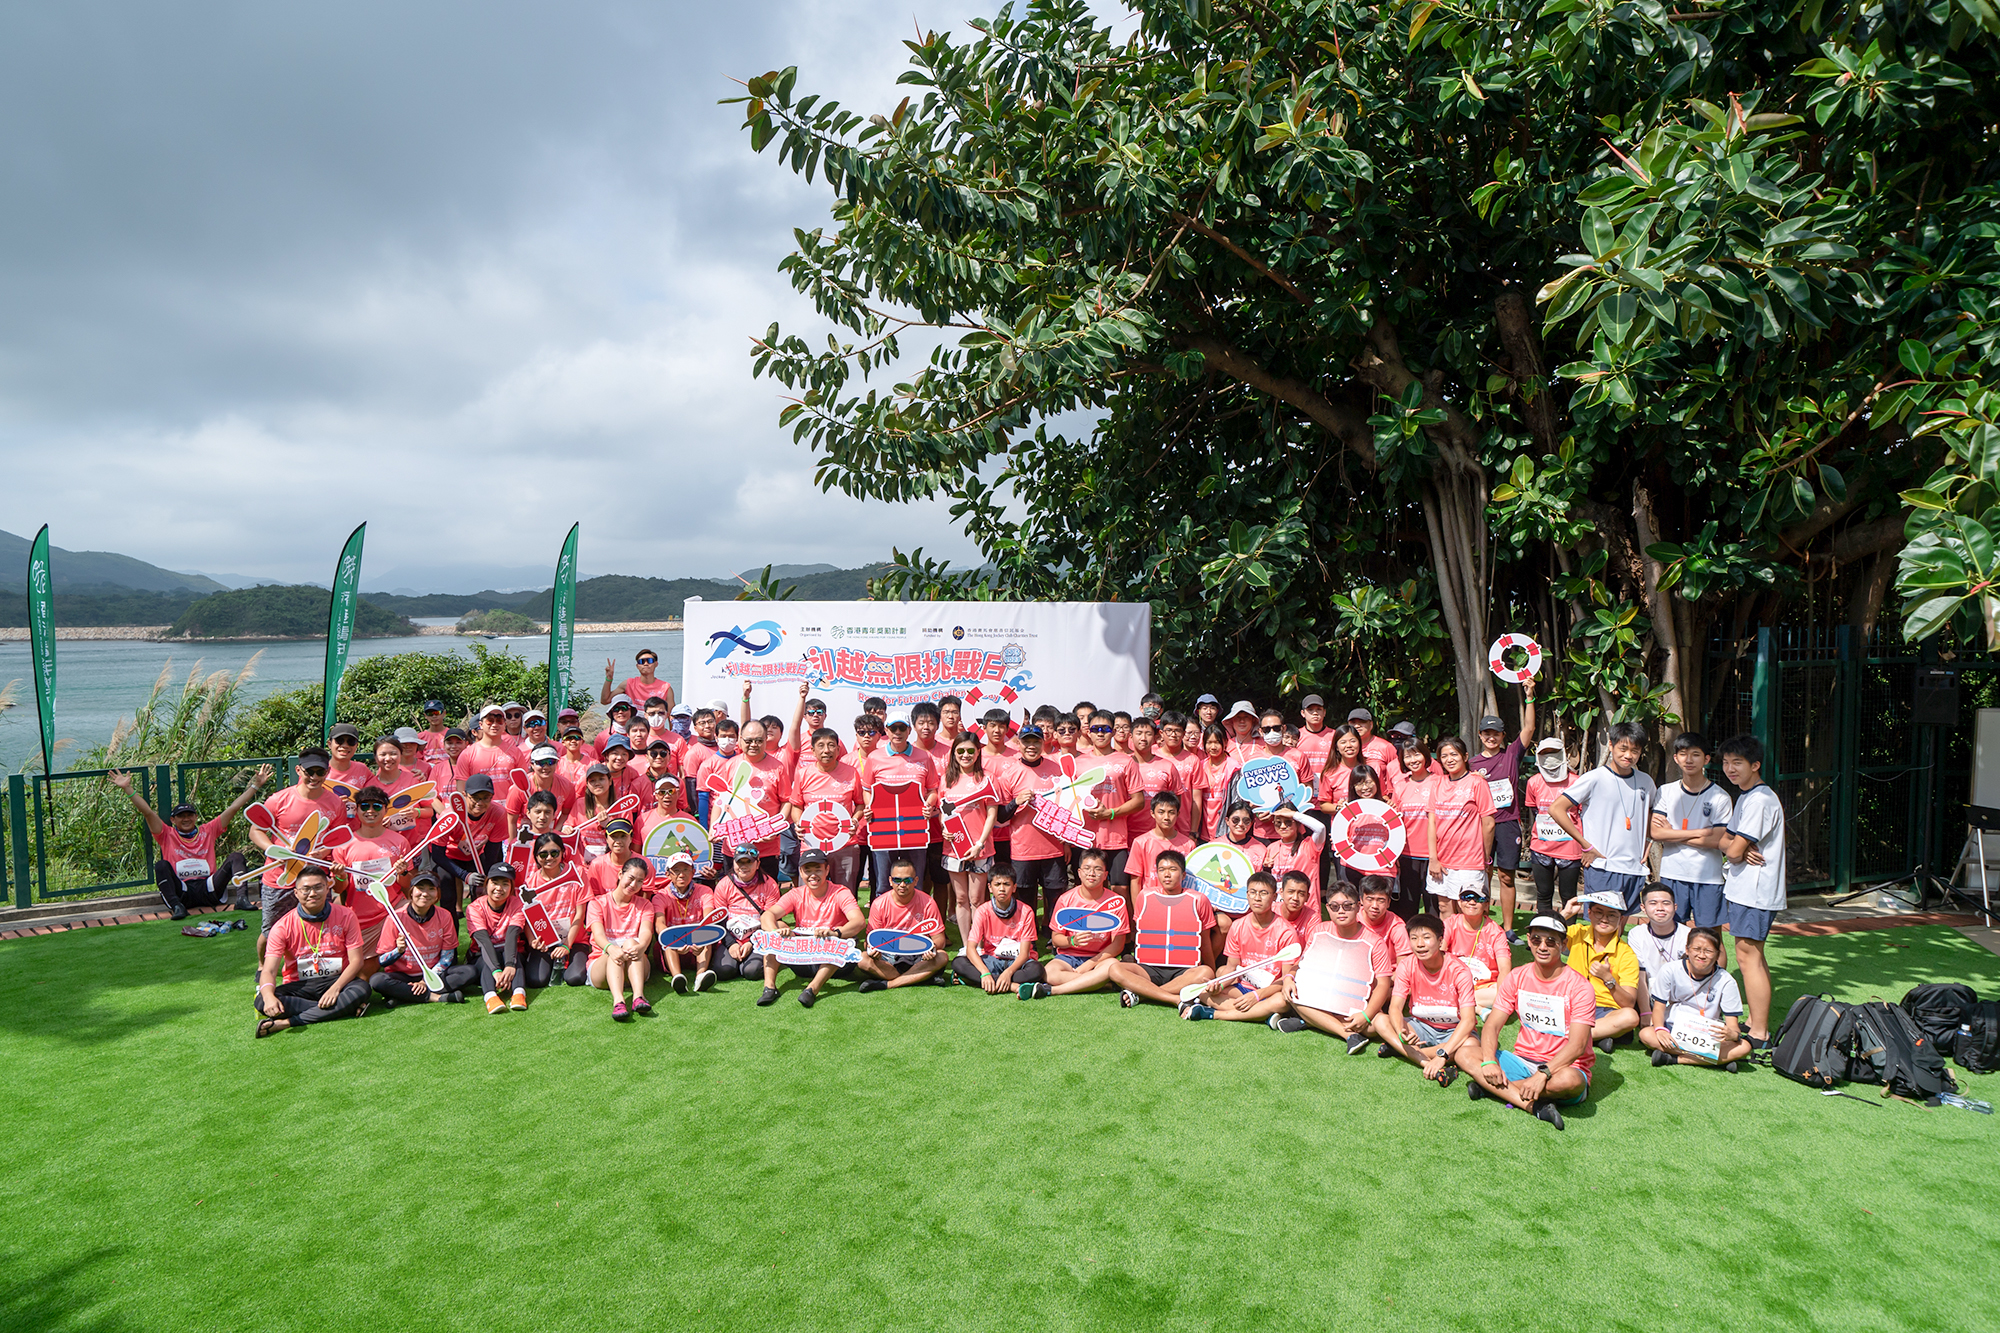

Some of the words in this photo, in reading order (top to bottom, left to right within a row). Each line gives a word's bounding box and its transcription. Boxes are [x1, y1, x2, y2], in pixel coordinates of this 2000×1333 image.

[898, 694, 929, 704] Future
[1244, 761, 1287, 777] EVERYBODY
[1246, 768, 1289, 788] ROWS
[453, 797, 464, 811] AYP
[620, 798, 634, 810] AYP
[439, 816, 453, 832] AYP
[1108, 899, 1121, 909] AYP
[712, 911, 724, 922] AYP
[920, 922, 934, 932] AYP
[834, 957, 844, 965] Day
[1525, 1012, 1557, 1027] SM-21
[1675, 1031, 1717, 1051] SI-02-1
